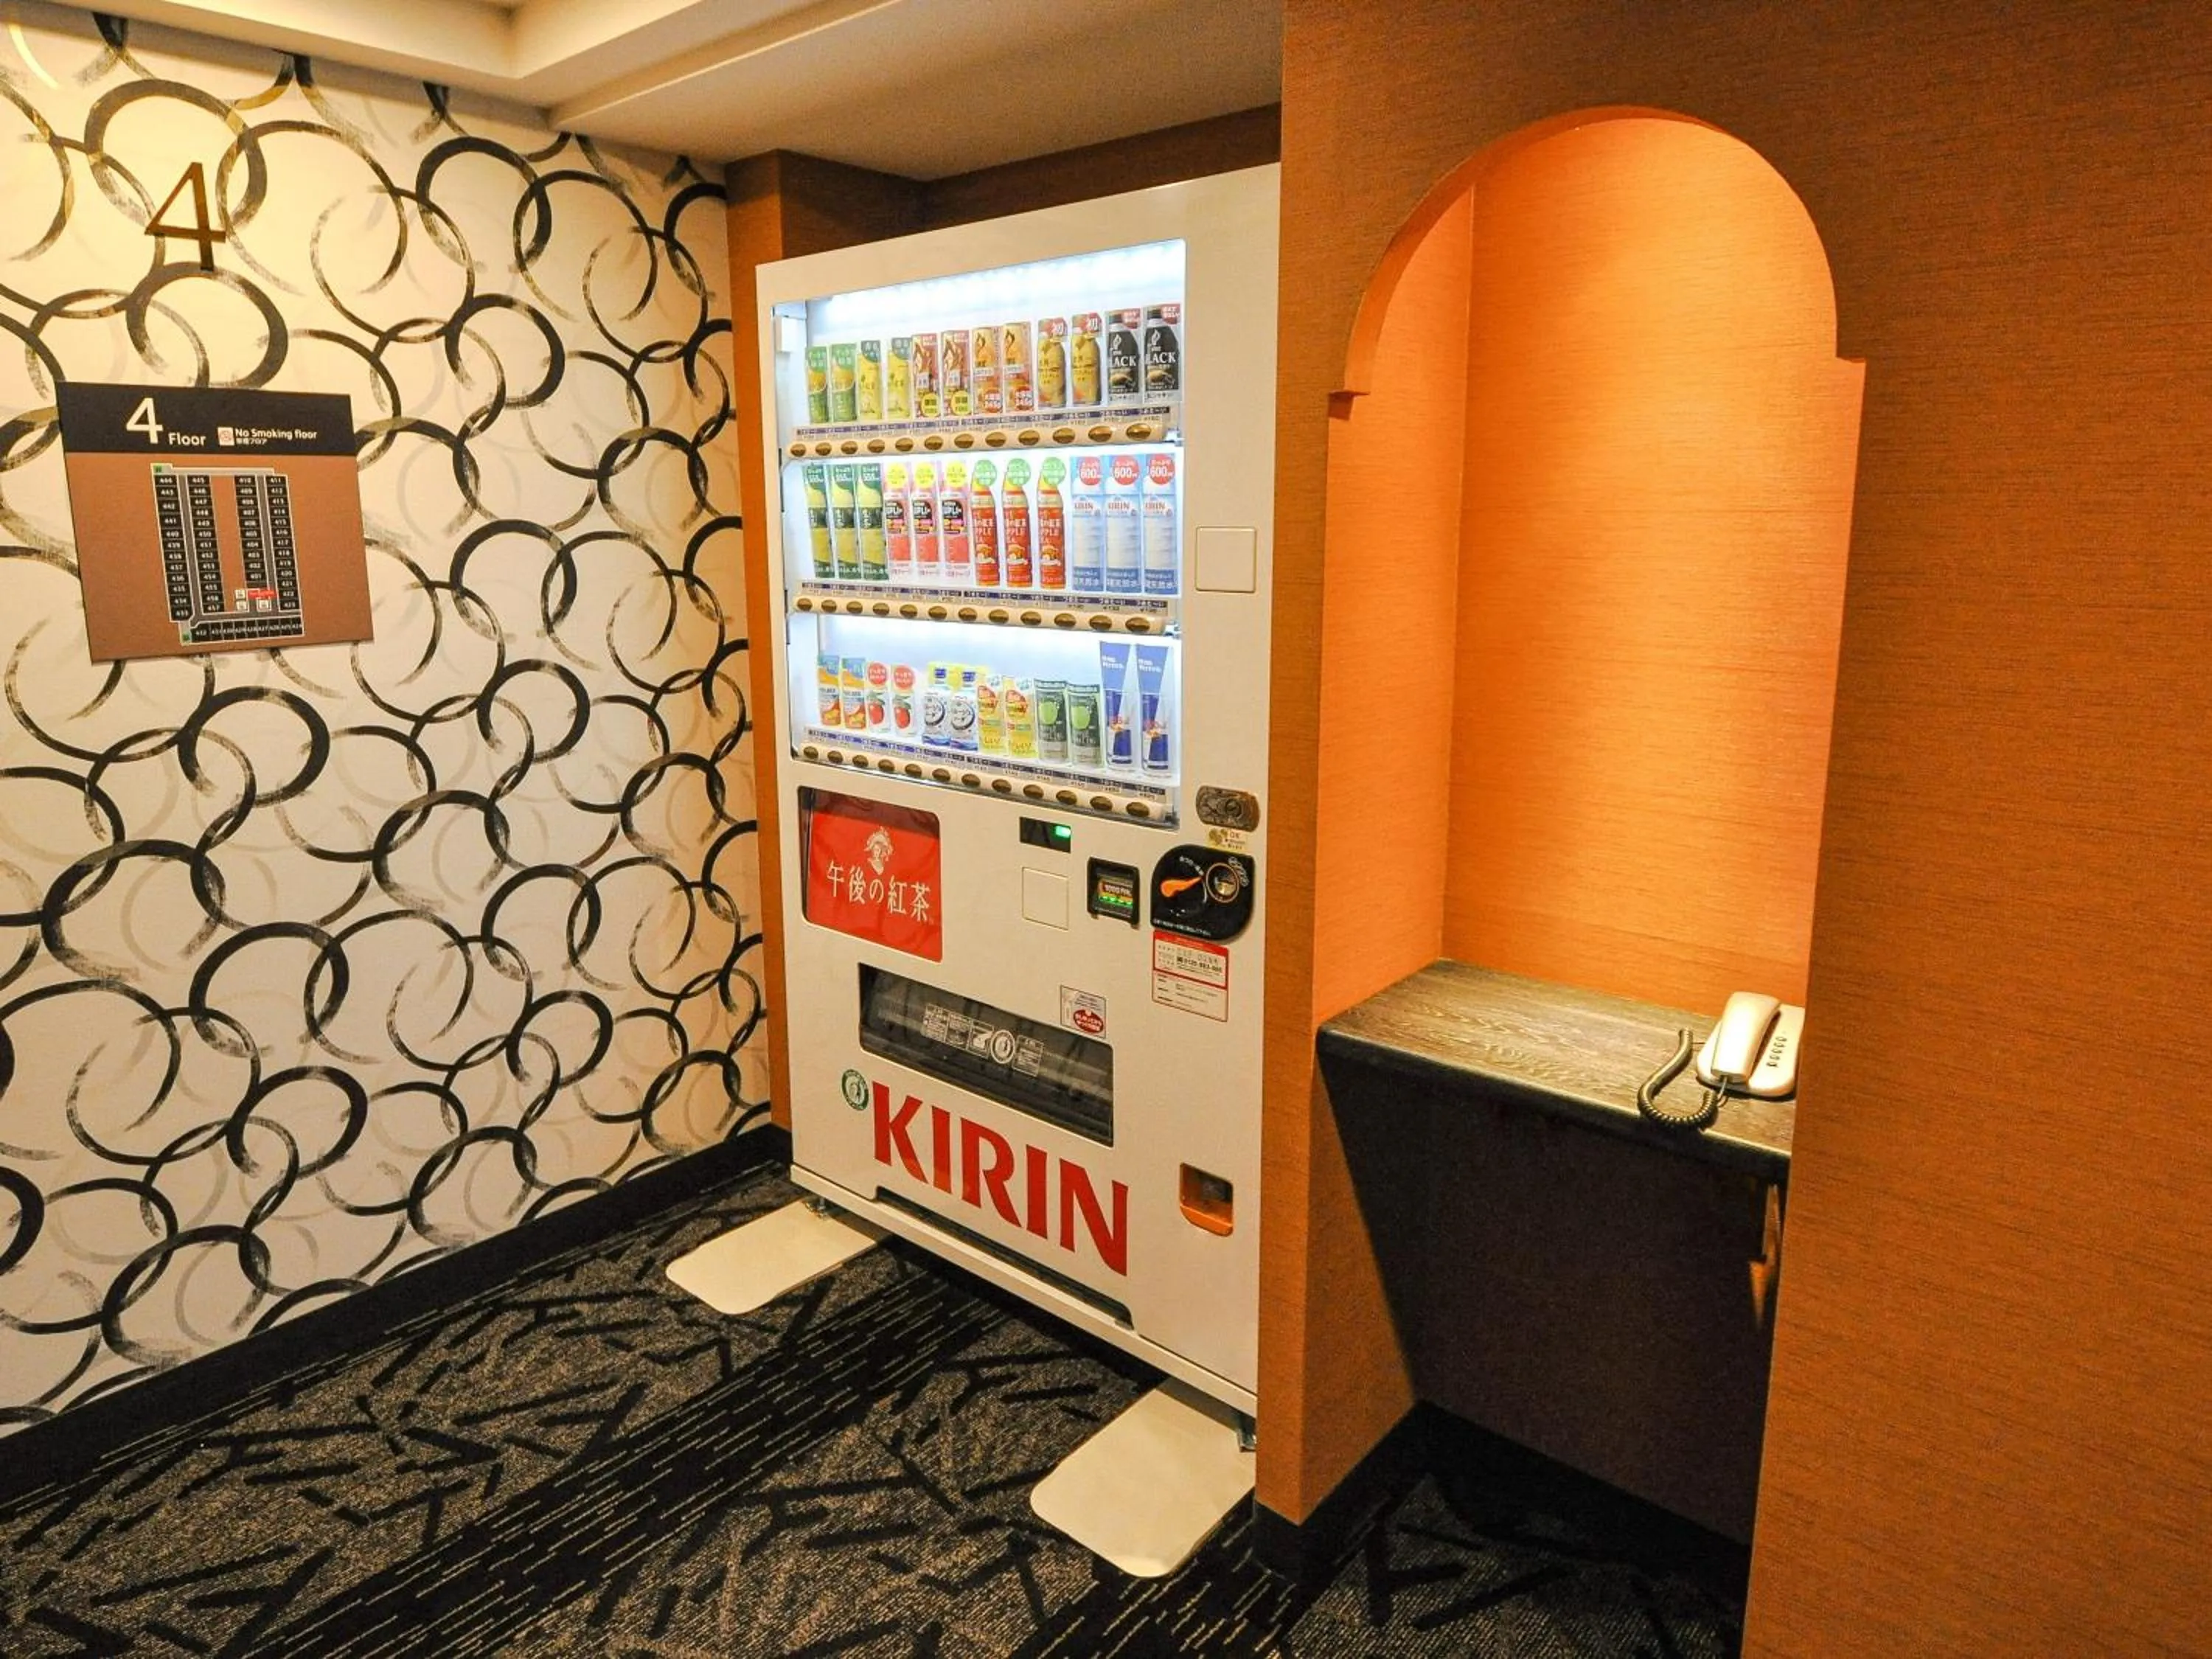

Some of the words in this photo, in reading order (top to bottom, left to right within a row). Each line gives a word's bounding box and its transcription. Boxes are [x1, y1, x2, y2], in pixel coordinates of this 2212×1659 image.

[144, 161, 226, 271] 4
[126, 397, 163, 443] 4
[168, 433, 206, 446] Floor
[235, 428, 249, 438] No
[251, 429, 293, 440] Smoking
[294, 429, 318, 439] floor
[827, 860, 931, 922] 午後の紅茶
[872, 1080, 1129, 1276] KIRIN
